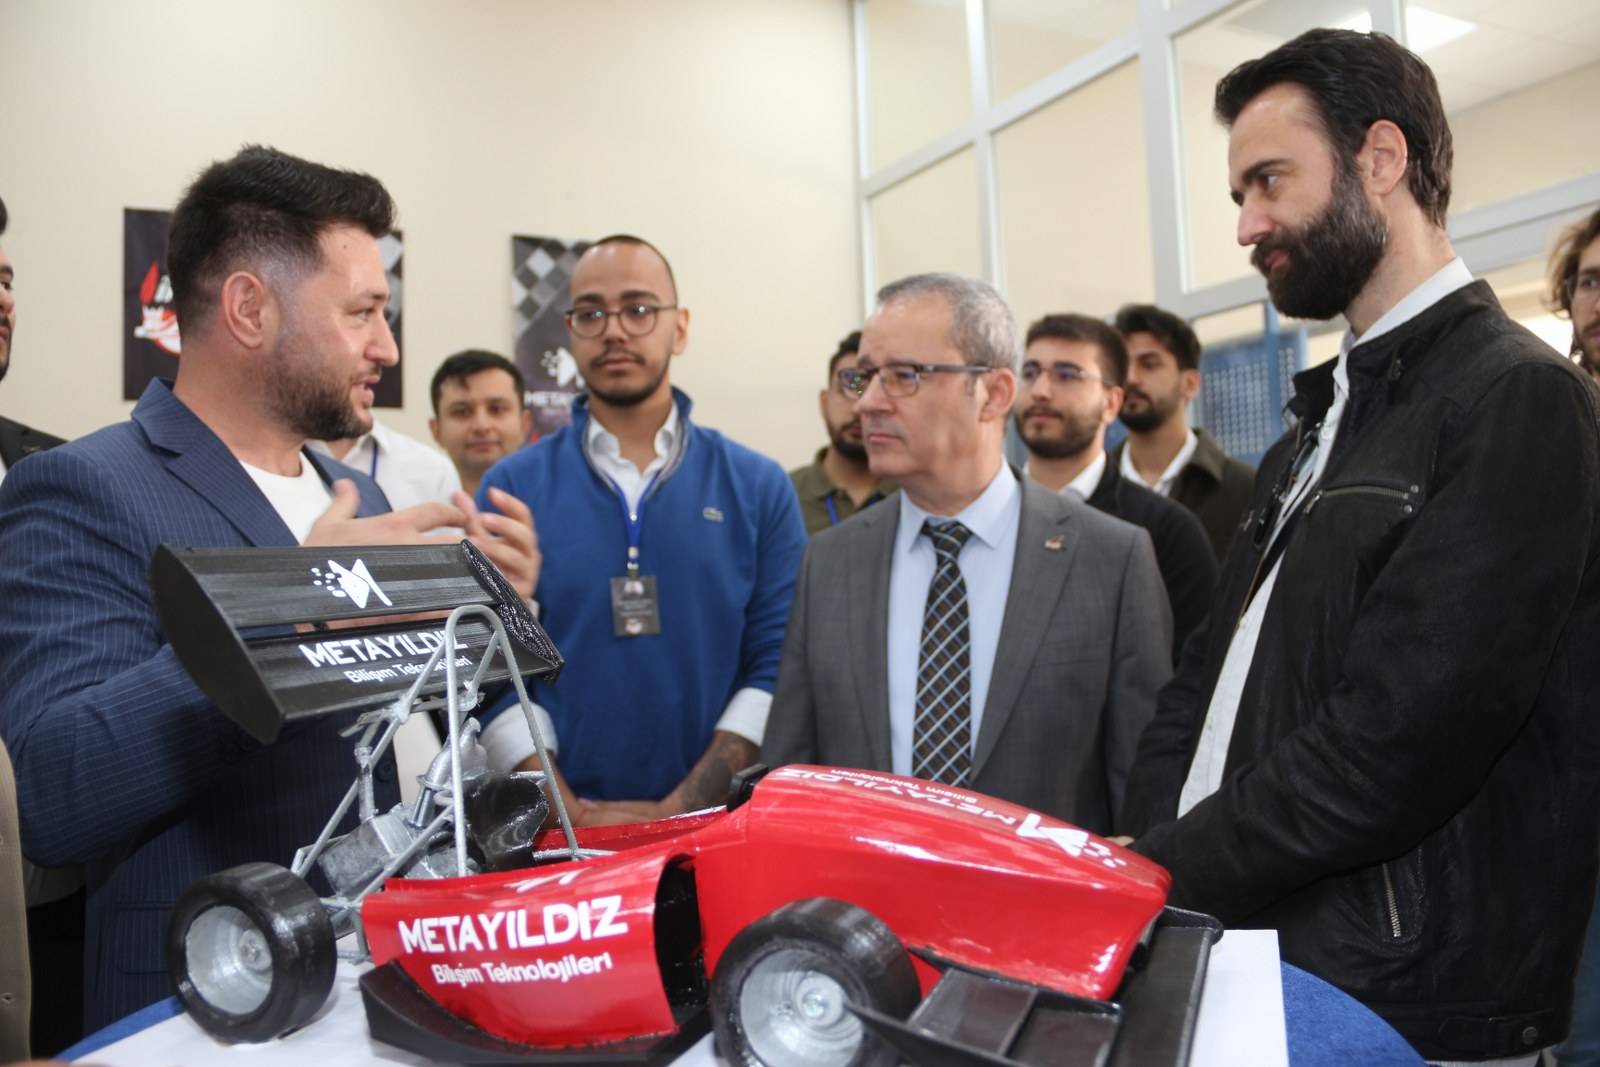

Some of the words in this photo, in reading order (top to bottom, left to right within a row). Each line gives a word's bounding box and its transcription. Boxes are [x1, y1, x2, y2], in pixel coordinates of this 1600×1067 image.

[775, 768, 1017, 824] METAYILDIZ
[397, 894, 630, 955] METAYILDIZ
[480, 951, 613, 985] Teknolojileri
